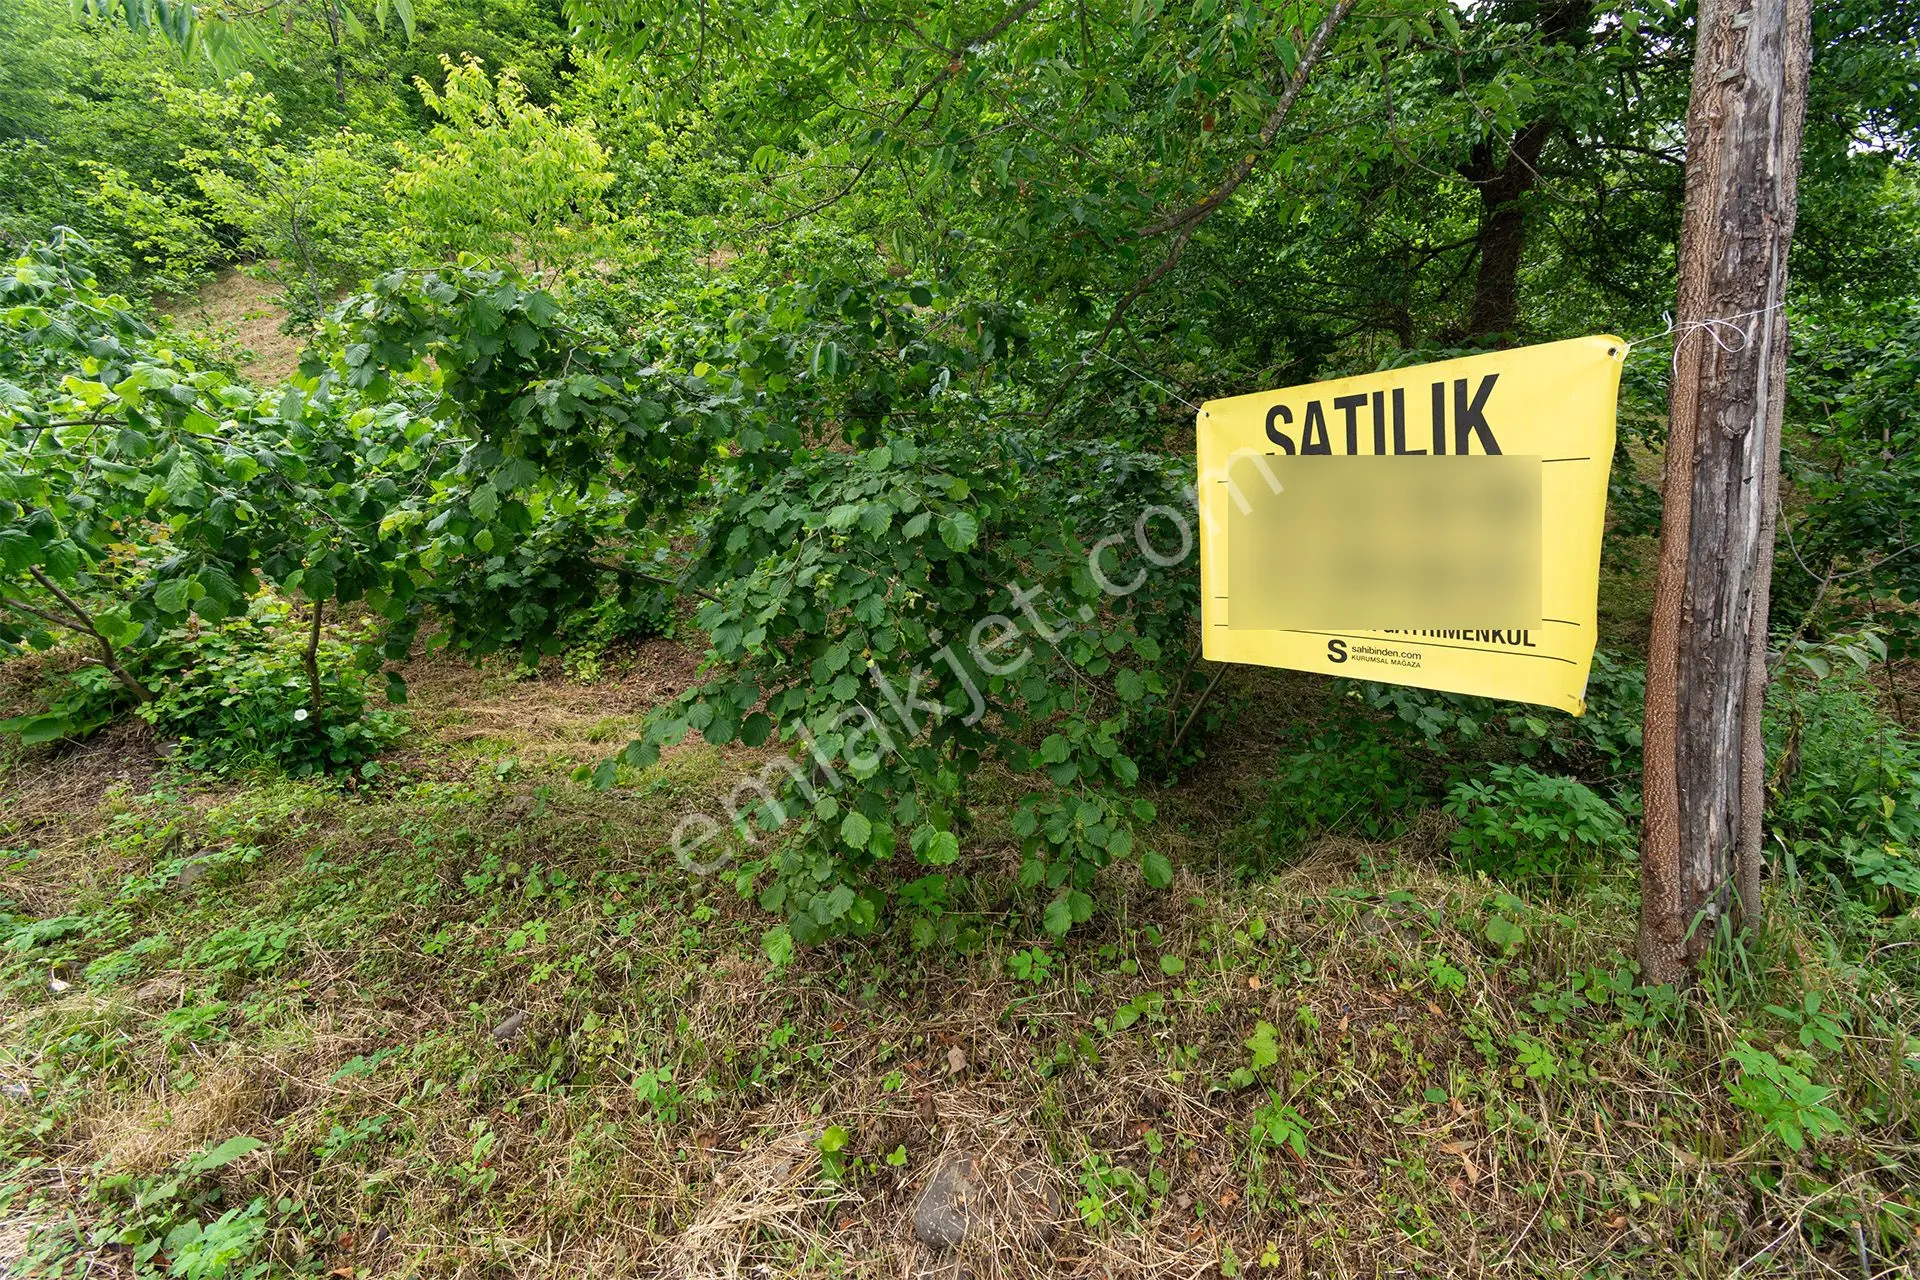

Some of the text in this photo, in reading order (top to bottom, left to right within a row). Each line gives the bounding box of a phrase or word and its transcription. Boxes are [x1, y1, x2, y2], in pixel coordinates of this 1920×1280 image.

[1265, 373, 1503, 455] SATILIK
[1384, 630, 1536, 647] MENKUL
[1327, 639, 1348, 663] S
[1351, 646, 1422, 660] sahibinden.com
[1351, 655, 1389, 665] KURUMSAL
